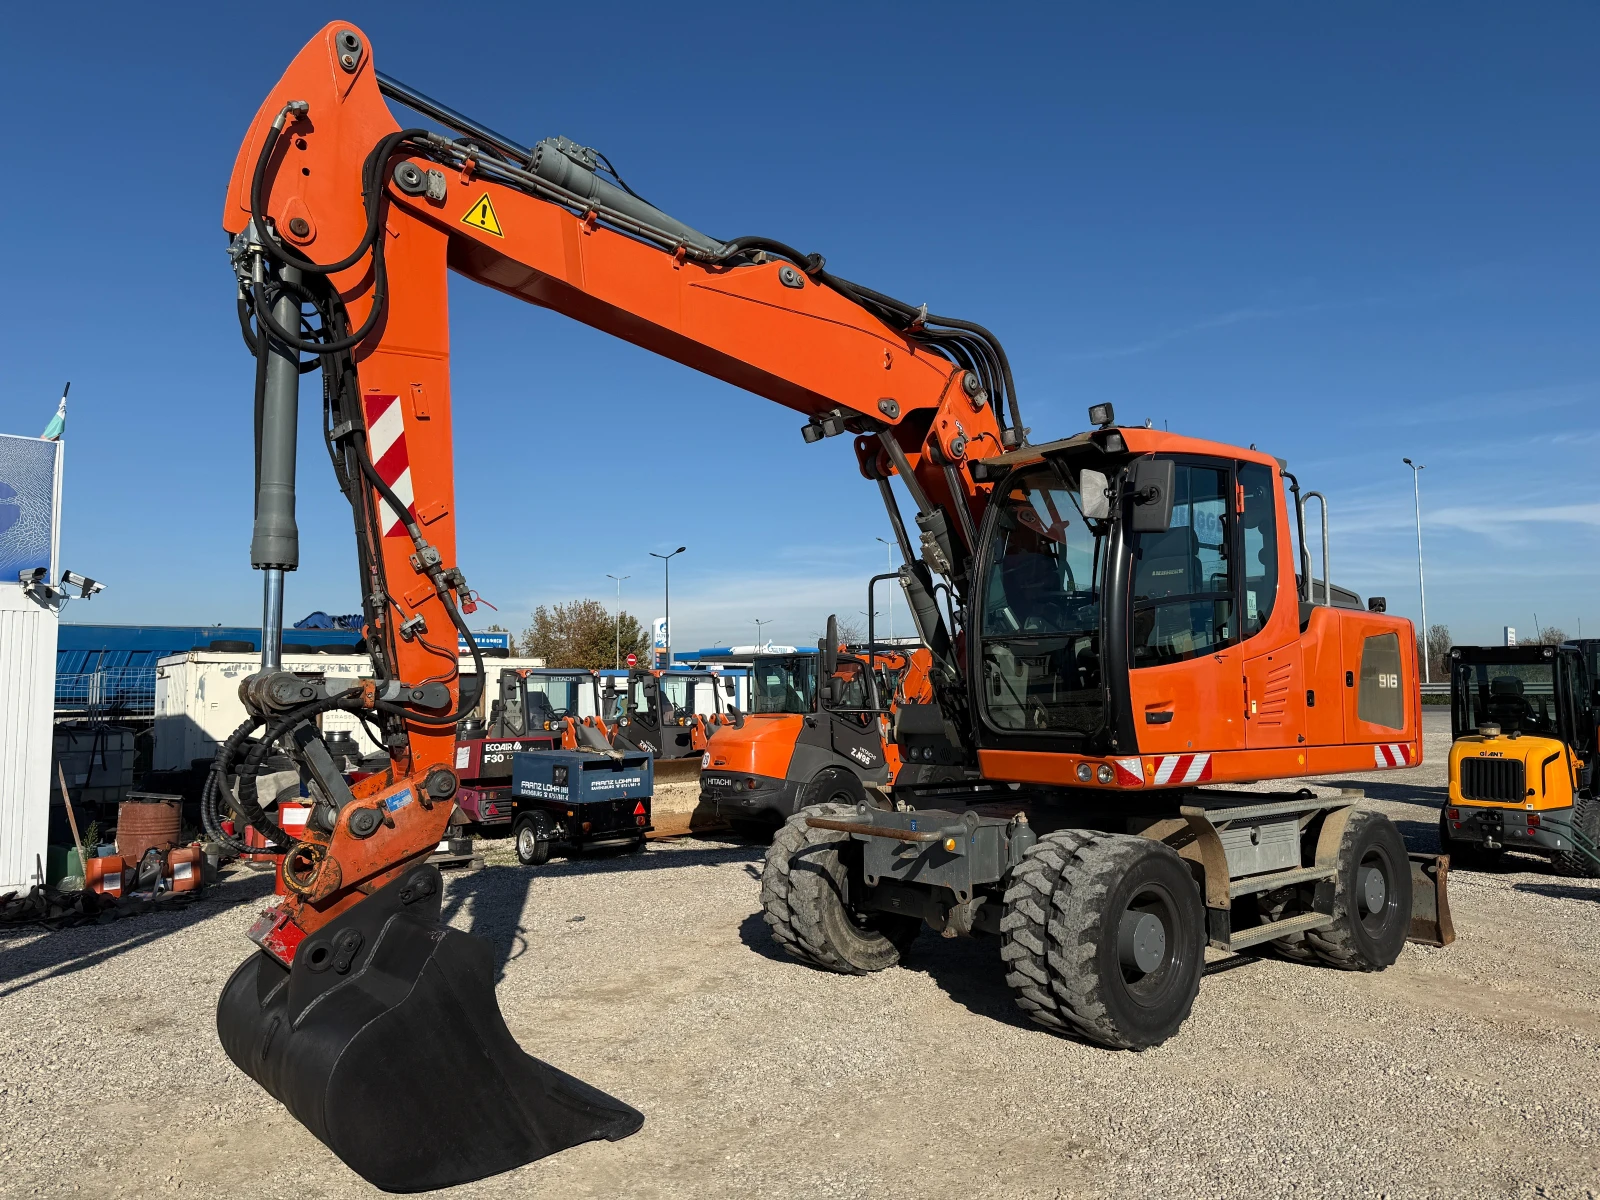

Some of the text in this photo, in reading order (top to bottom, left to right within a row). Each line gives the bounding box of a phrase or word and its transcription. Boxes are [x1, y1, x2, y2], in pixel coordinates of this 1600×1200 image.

[1378, 673, 1398, 689] 916
[485, 742, 513, 752] ECOAIR
[484, 753, 505, 764] F30
[859, 746, 877, 761] HITACHI
[520, 780, 542, 791] FRANZ
[590, 779, 614, 787] FRANZ
[707, 778, 732, 786] HITACHI
